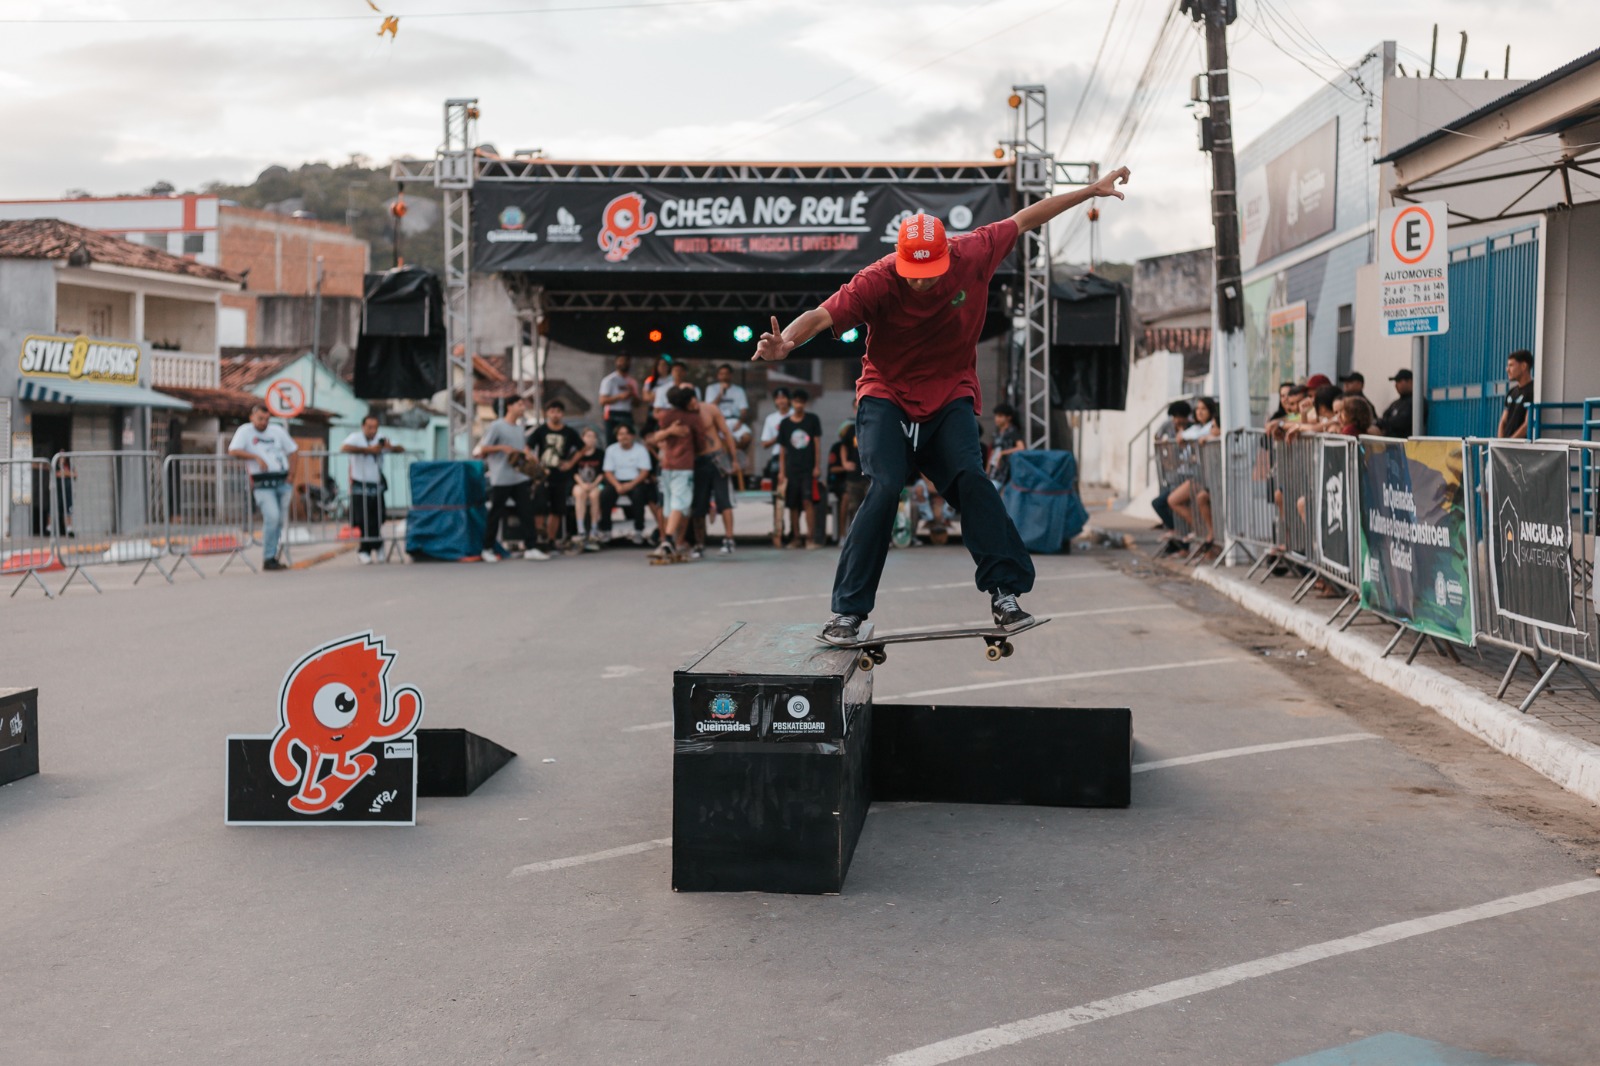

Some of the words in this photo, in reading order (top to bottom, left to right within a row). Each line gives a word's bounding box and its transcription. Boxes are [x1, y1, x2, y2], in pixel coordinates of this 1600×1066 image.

[660, 196, 747, 228] CHEGA
[753, 196, 797, 225] NO
[799, 191, 870, 225] ROLÉ
[674, 237, 709, 253] MUITO
[710, 237, 748, 254] SKATE,
[749, 234, 791, 252] MÚSICA
[792, 235, 800, 251] E
[1406, 219, 1421, 252] E
[21, 339, 72, 373] STYLE
[279, 386, 292, 410] E
[1520, 520, 1564, 547] ANGULAR
[1520, 546, 1566, 570] SKATEPARKS
[696, 721, 751, 733] Queimadas
[772, 721, 825, 730] PBSKATEBOARD
